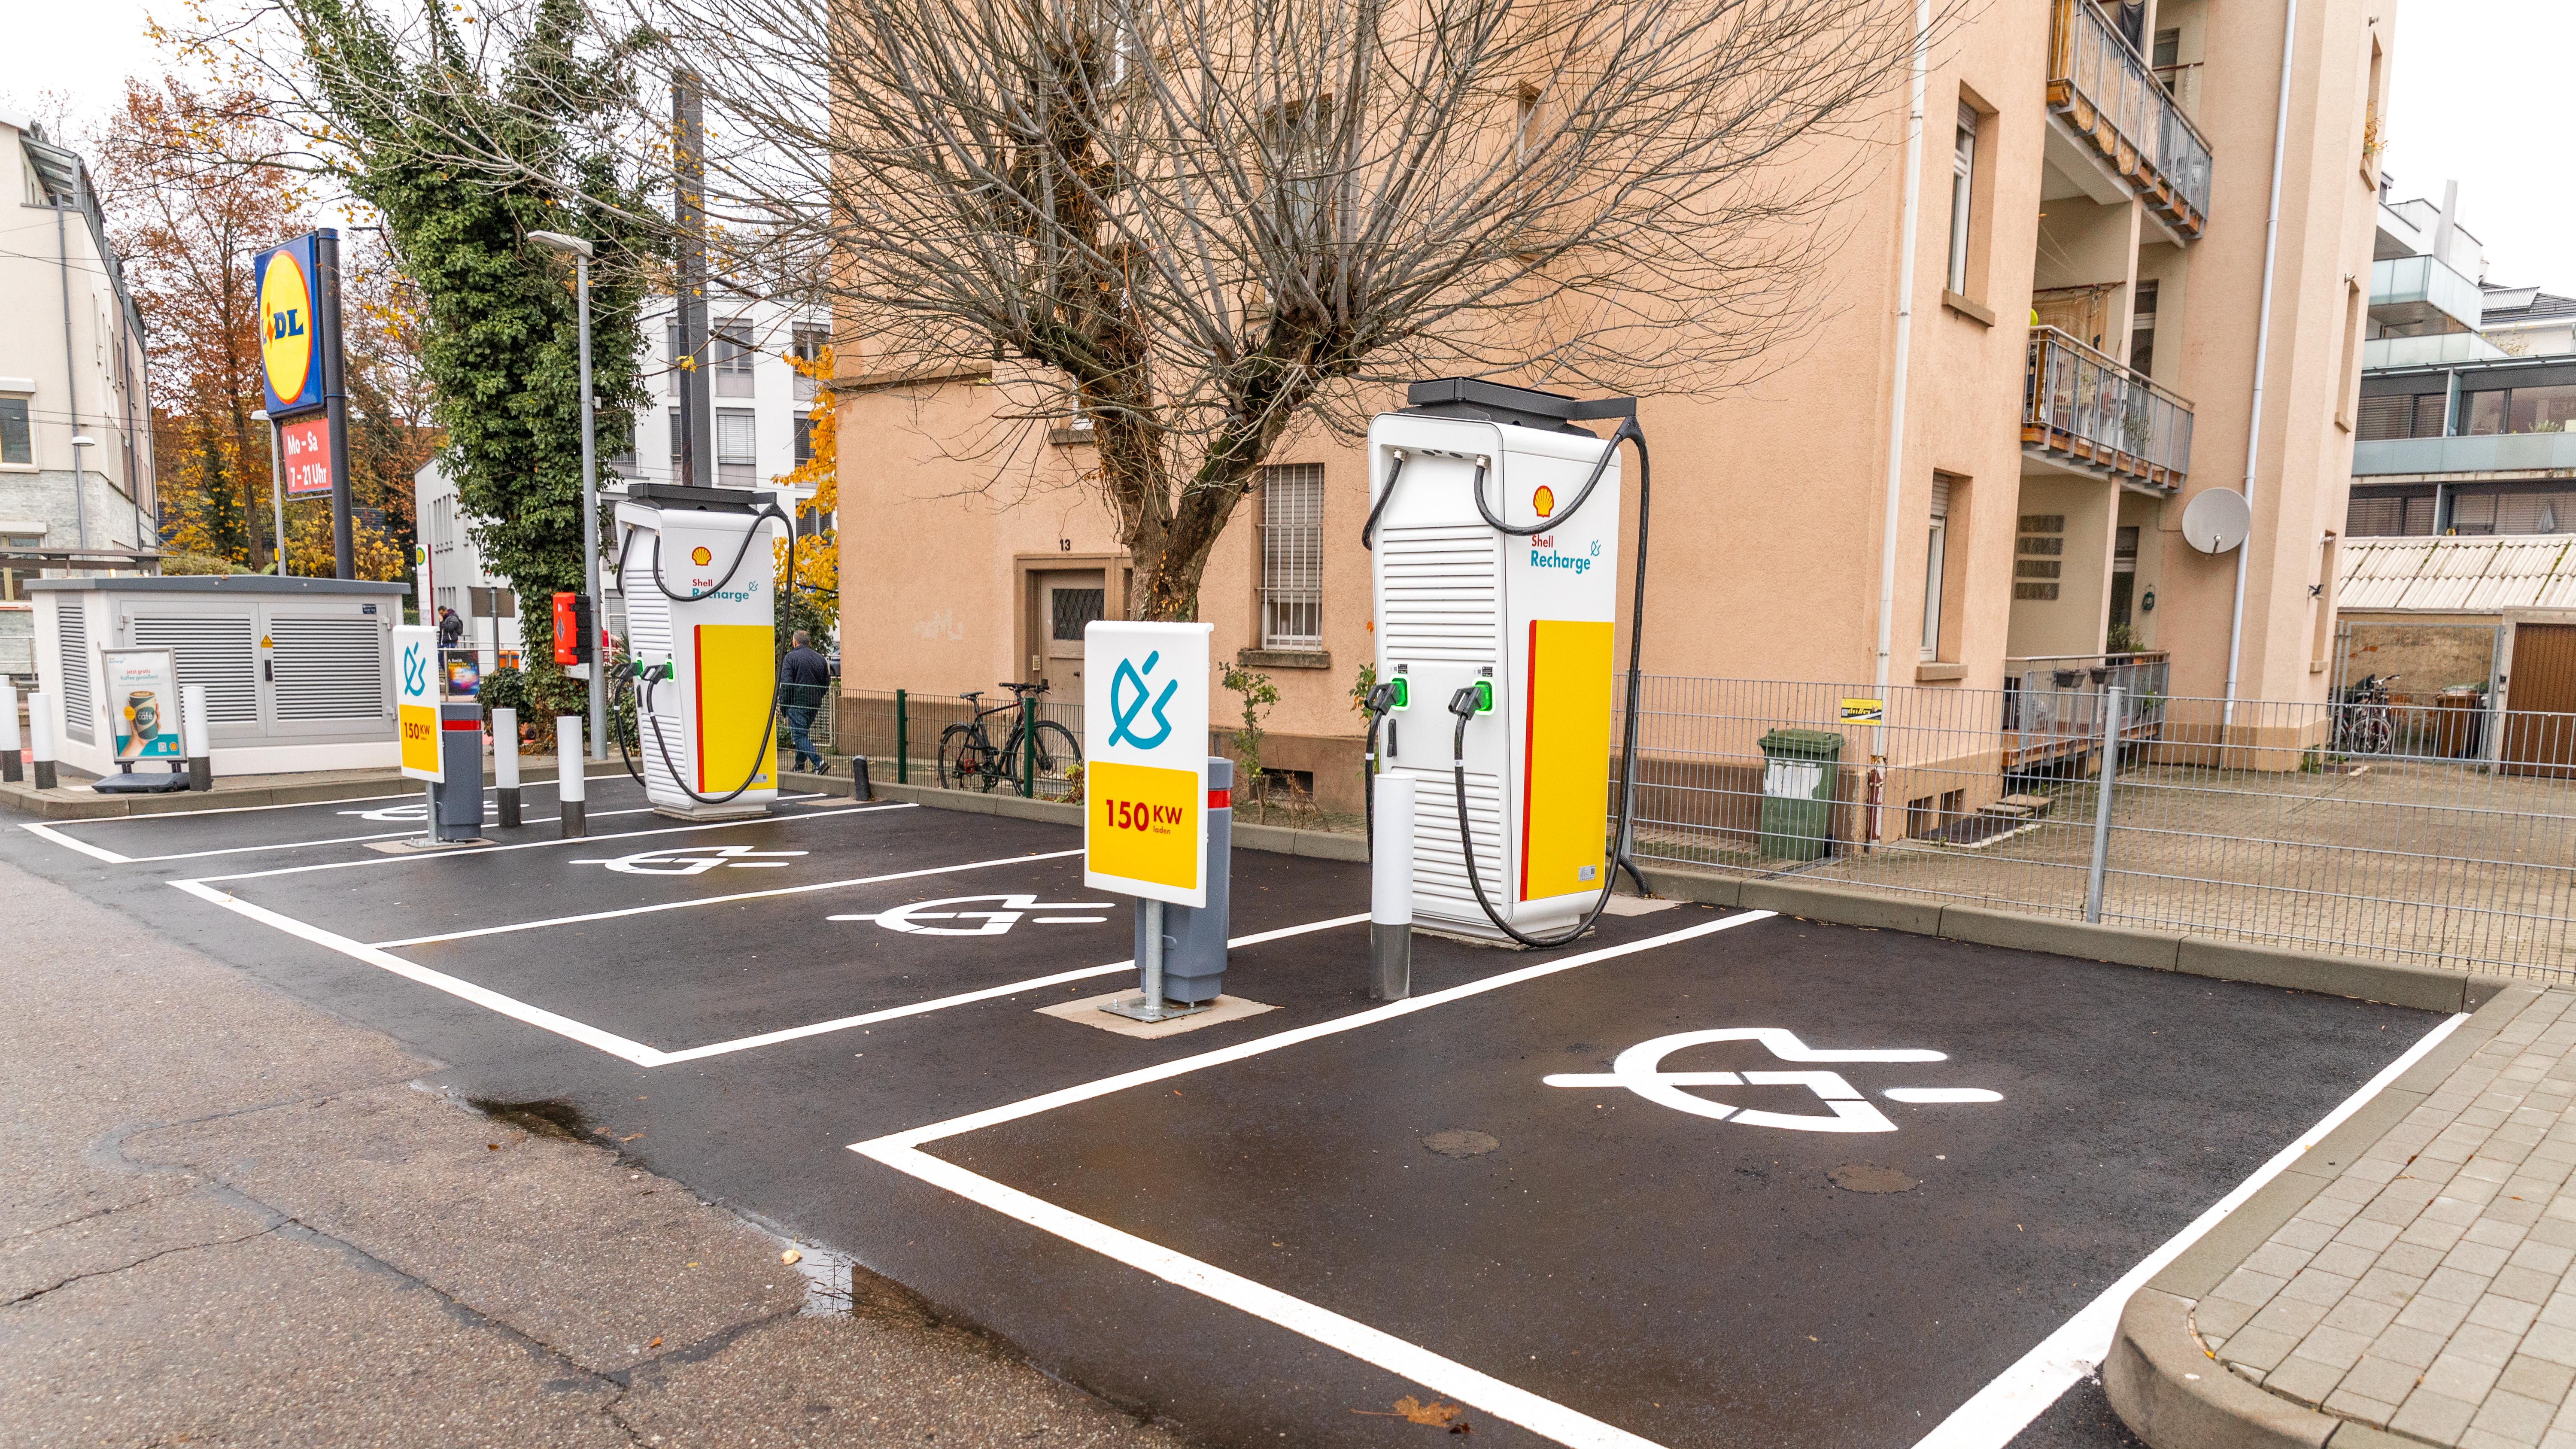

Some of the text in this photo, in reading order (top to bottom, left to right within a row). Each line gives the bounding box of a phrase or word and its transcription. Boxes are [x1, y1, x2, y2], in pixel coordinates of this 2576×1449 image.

[287, 434, 300, 455] Mo
[307, 431, 318, 452] Sa
[290, 467, 295, 487] 7
[303, 465, 312, 486] 21
[312, 463, 327, 484] Uhr
[1060, 539, 1071, 552] 13
[1532, 535, 1553, 547] Shell
[1531, 550, 1590, 574] Recharge
[138, 711, 153, 720] café
[404, 722, 430, 739] 150 KW
[1106, 799, 1182, 831] 150 KW
[1153, 825, 1171, 834] laden
